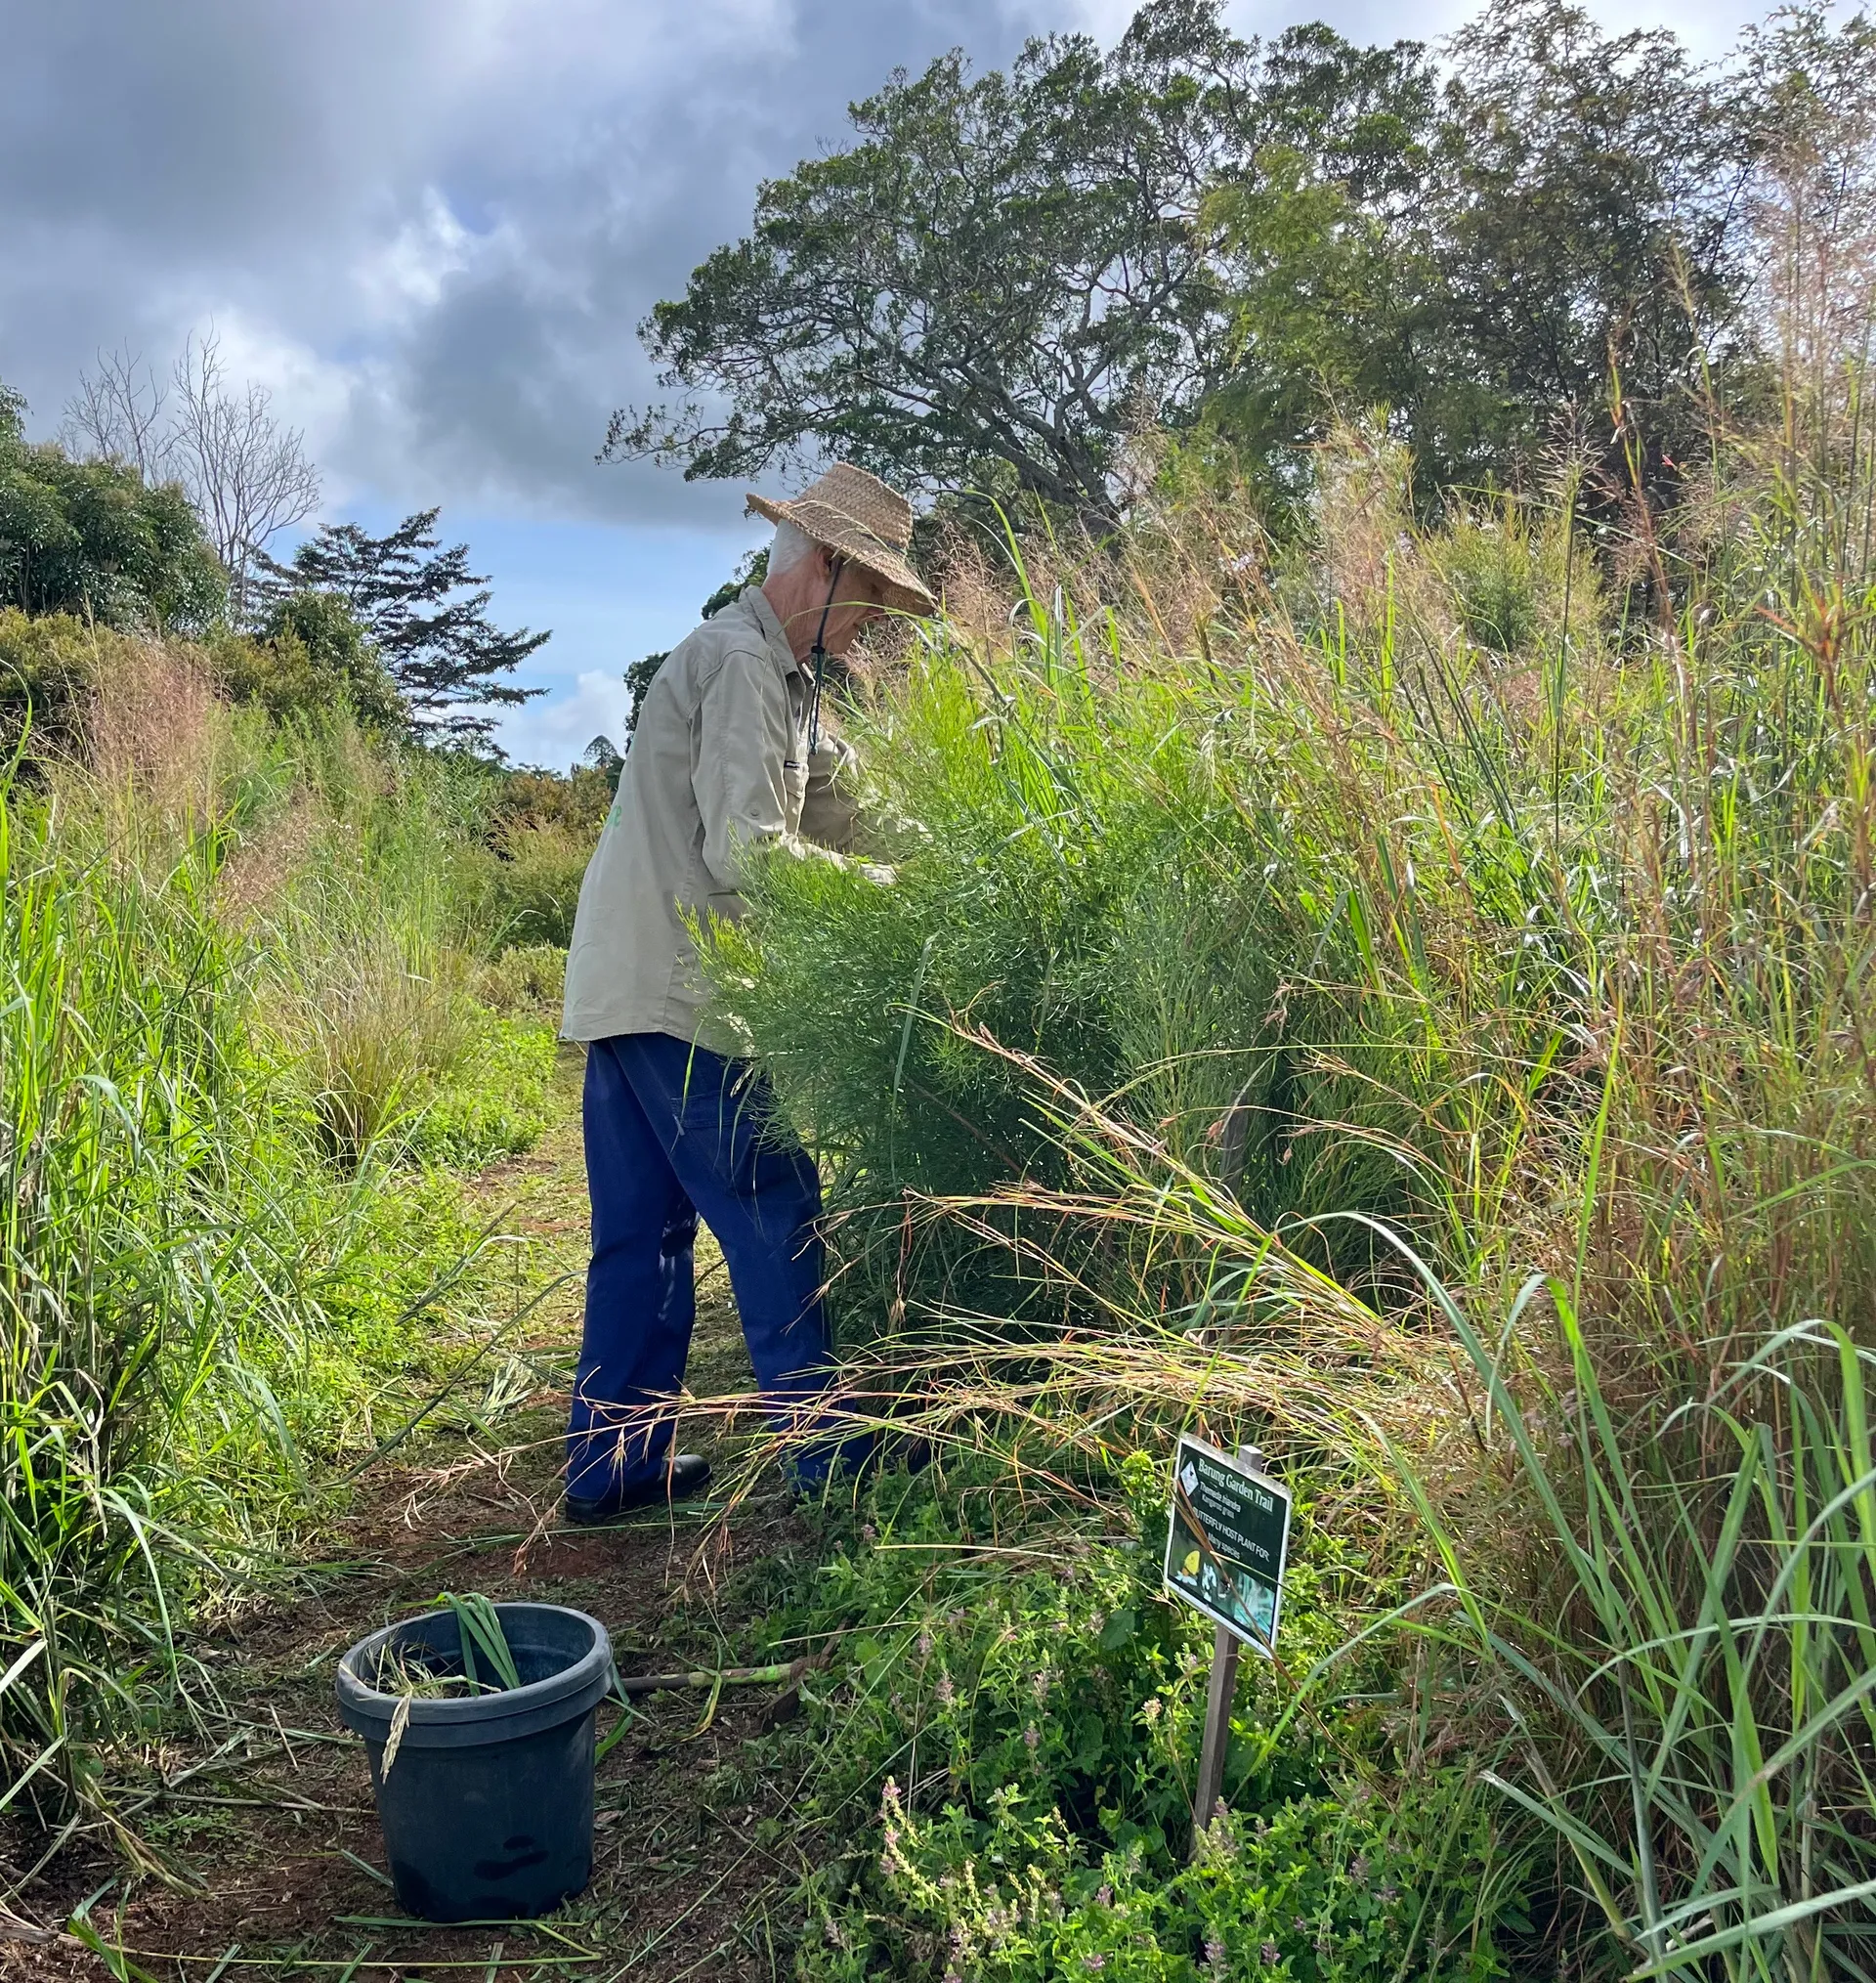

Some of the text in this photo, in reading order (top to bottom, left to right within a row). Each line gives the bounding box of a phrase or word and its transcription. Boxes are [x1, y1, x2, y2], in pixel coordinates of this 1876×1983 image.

[1198, 1458, 1225, 1487] Barung
[1226, 1474, 1253, 1500] Garden
[1255, 1488, 1273, 1512] Trail
[1221, 1542, 1240, 1560] species
[1222, 1525, 1238, 1541] HOST
[1237, 1533, 1257, 1552] PLANT
